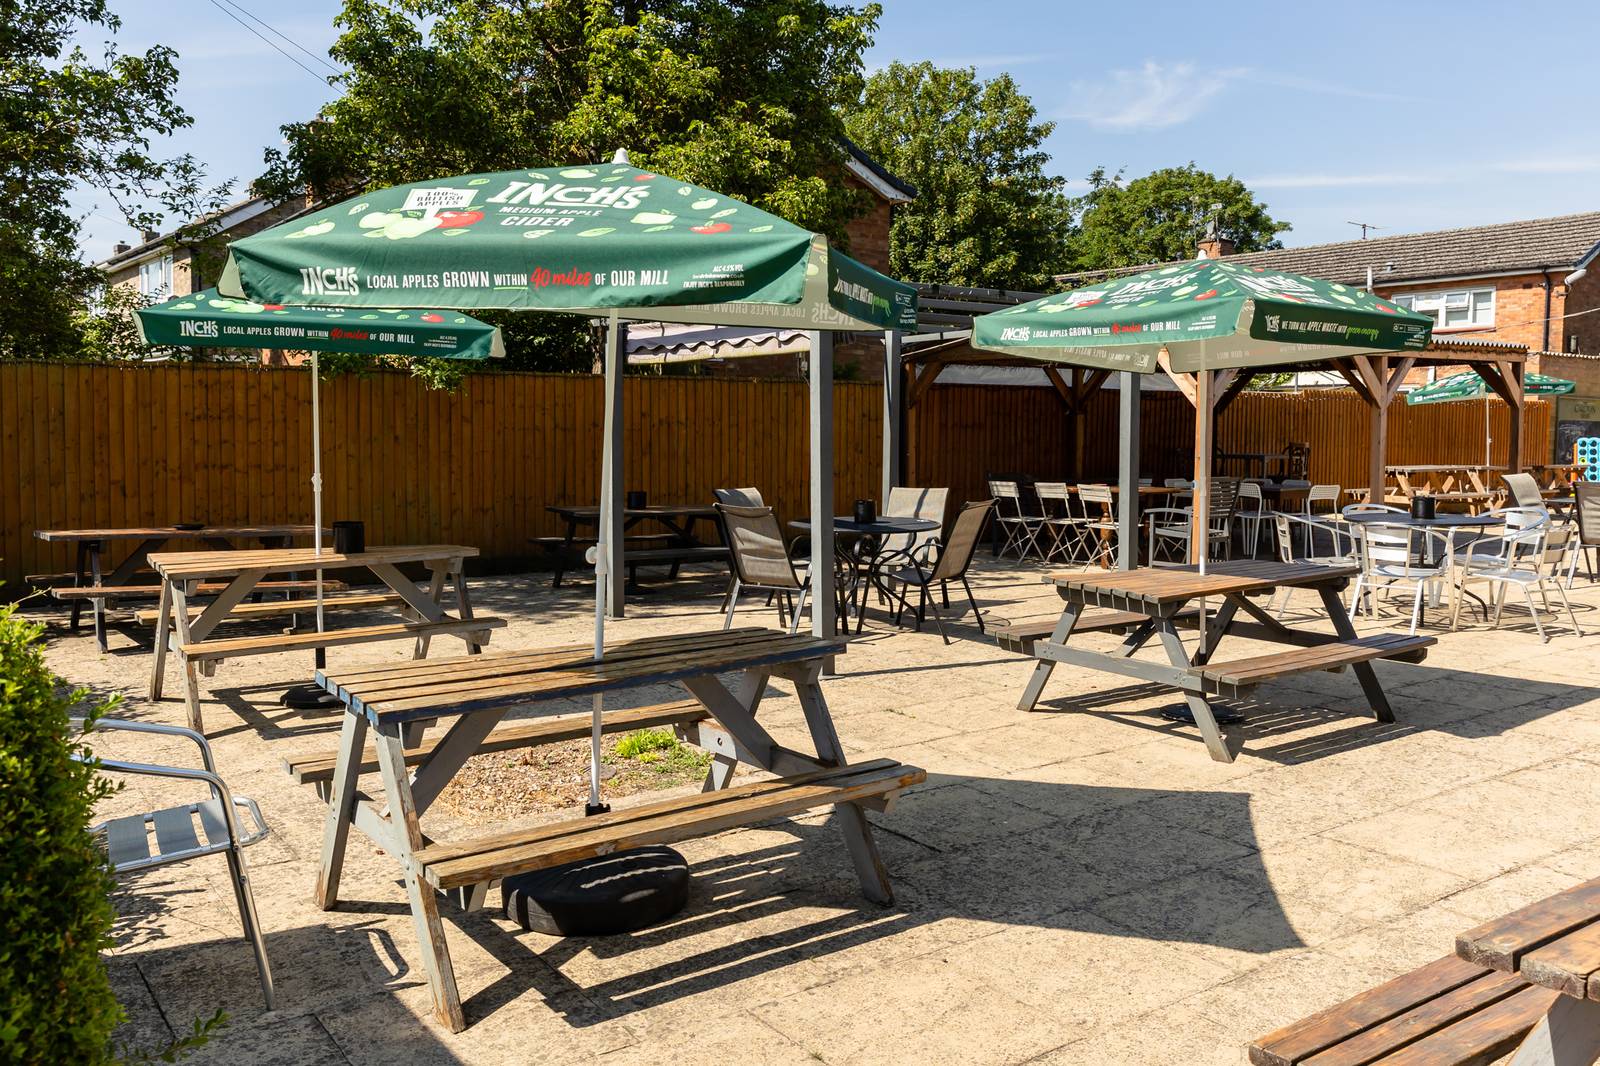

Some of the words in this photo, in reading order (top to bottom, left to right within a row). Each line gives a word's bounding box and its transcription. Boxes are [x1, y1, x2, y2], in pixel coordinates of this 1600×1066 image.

[486, 181, 651, 210] INCH'S
[499, 206, 557, 215] MEDIUM
[559, 207, 604, 217] APPLE
[500, 216, 576, 227] CIDER
[299, 266, 360, 296] INCH'S
[367, 275, 399, 289] LOCAL
[402, 274, 439, 289] APPLES
[443, 271, 490, 288] GROWN
[494, 273, 528, 286] WITHIN
[530, 266, 549, 289] 40
[552, 267, 593, 288] miles
[595, 273, 607, 286] OF
[611, 270, 635, 287] OUR
[640, 269, 669, 286] MILL
[223, 326, 245, 335] LOCAL
[246, 326, 272, 336] APPLES
[273, 326, 305, 337] GROWN
[307, 329, 329, 337] WITHIN
[370, 333, 377, 341] OF
[379, 332, 394, 343] OUR
[397, 334, 415, 344] MILL
[1033, 330, 1048, 338] LOCAL
[1050, 329, 1068, 338] APPLES
[1069, 327, 1092, 336] GROWN
[1143, 324, 1149, 332] OF
[1150, 322, 1163, 332] OUR
[1165, 320, 1181, 331] MILL
[1307, 321, 1321, 332] APPLE
[1322, 322, 1338, 333] WASTE
